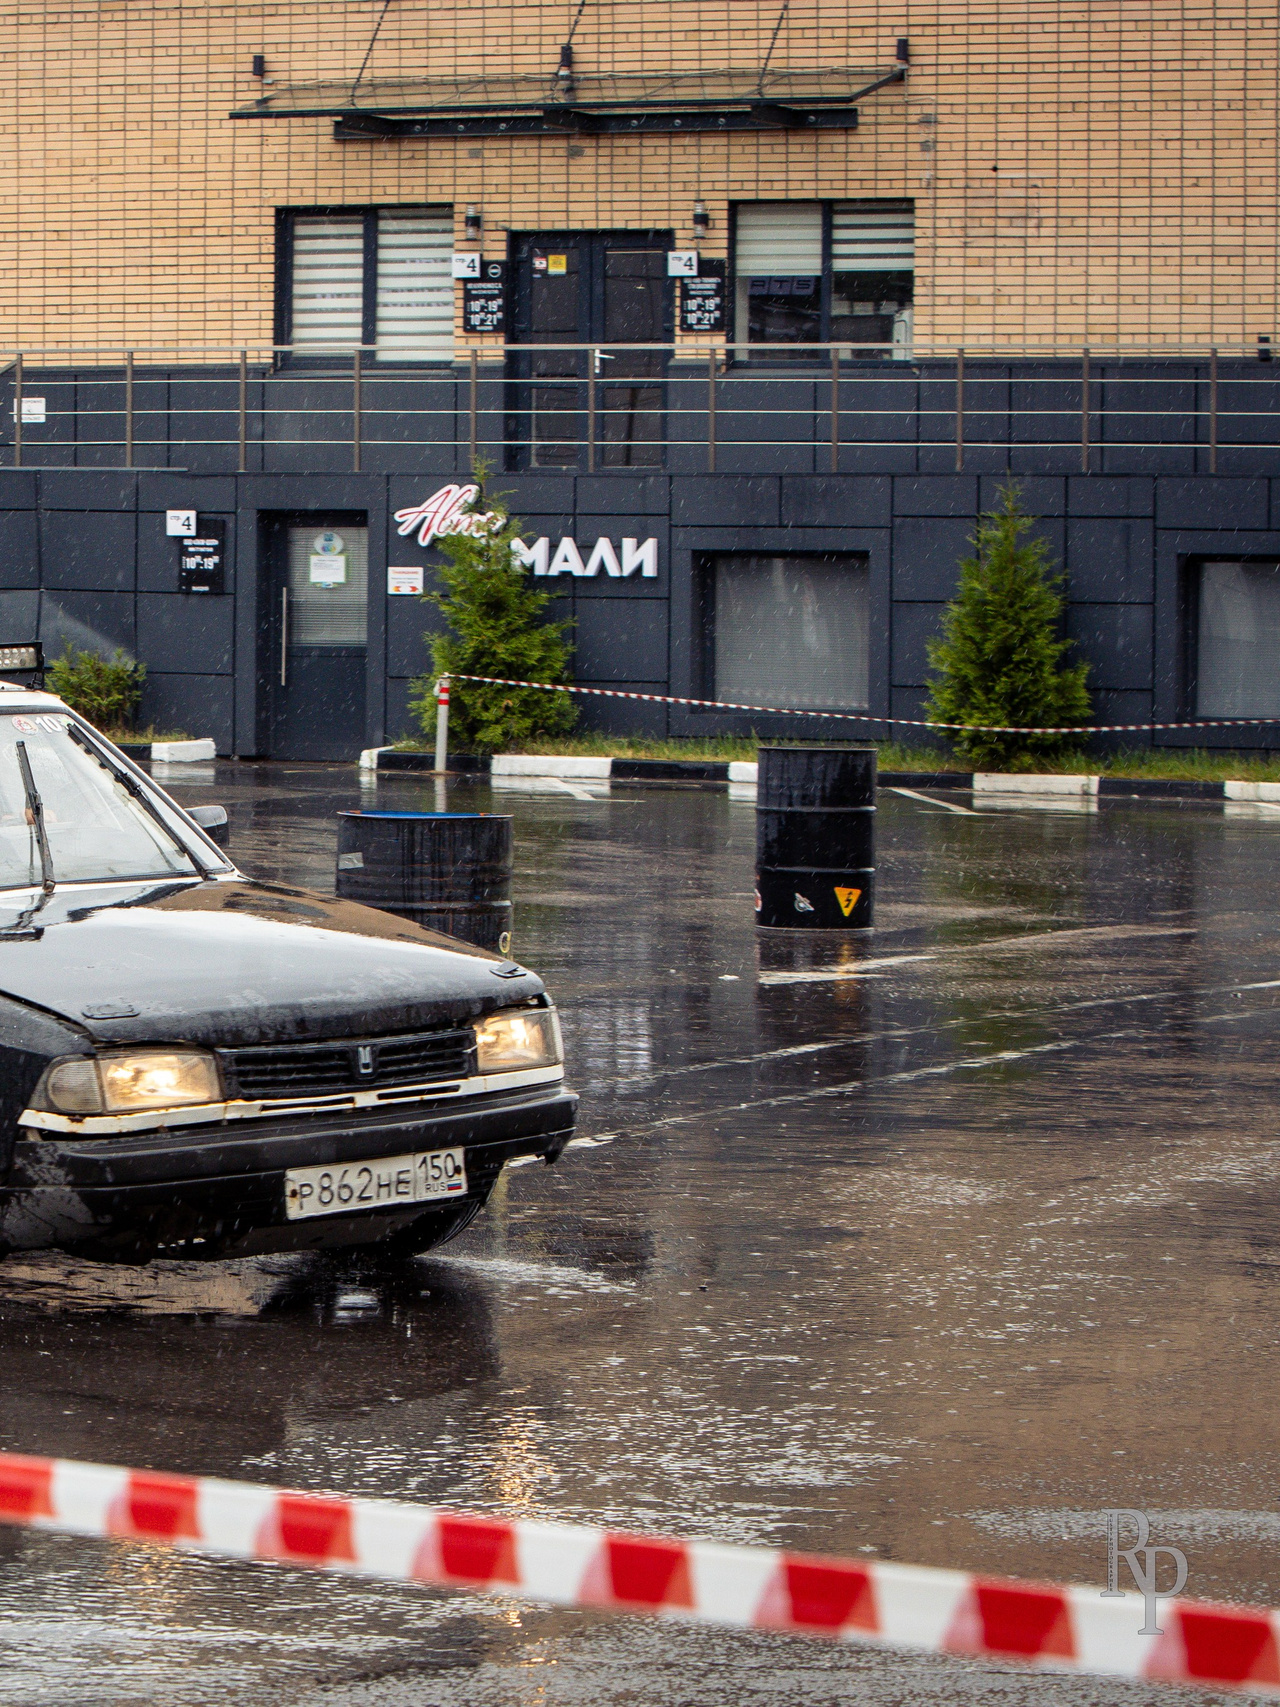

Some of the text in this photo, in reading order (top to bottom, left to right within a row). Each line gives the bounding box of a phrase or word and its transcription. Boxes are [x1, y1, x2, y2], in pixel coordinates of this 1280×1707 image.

[466, 258, 477, 273] 4
[683, 256, 694, 271] 4
[181, 516, 192, 531] 4
[35, 715, 62, 734] 10
[298, 1152, 458, 1212] Р862НЕ 150
[424, 1181, 448, 1194] RUS
